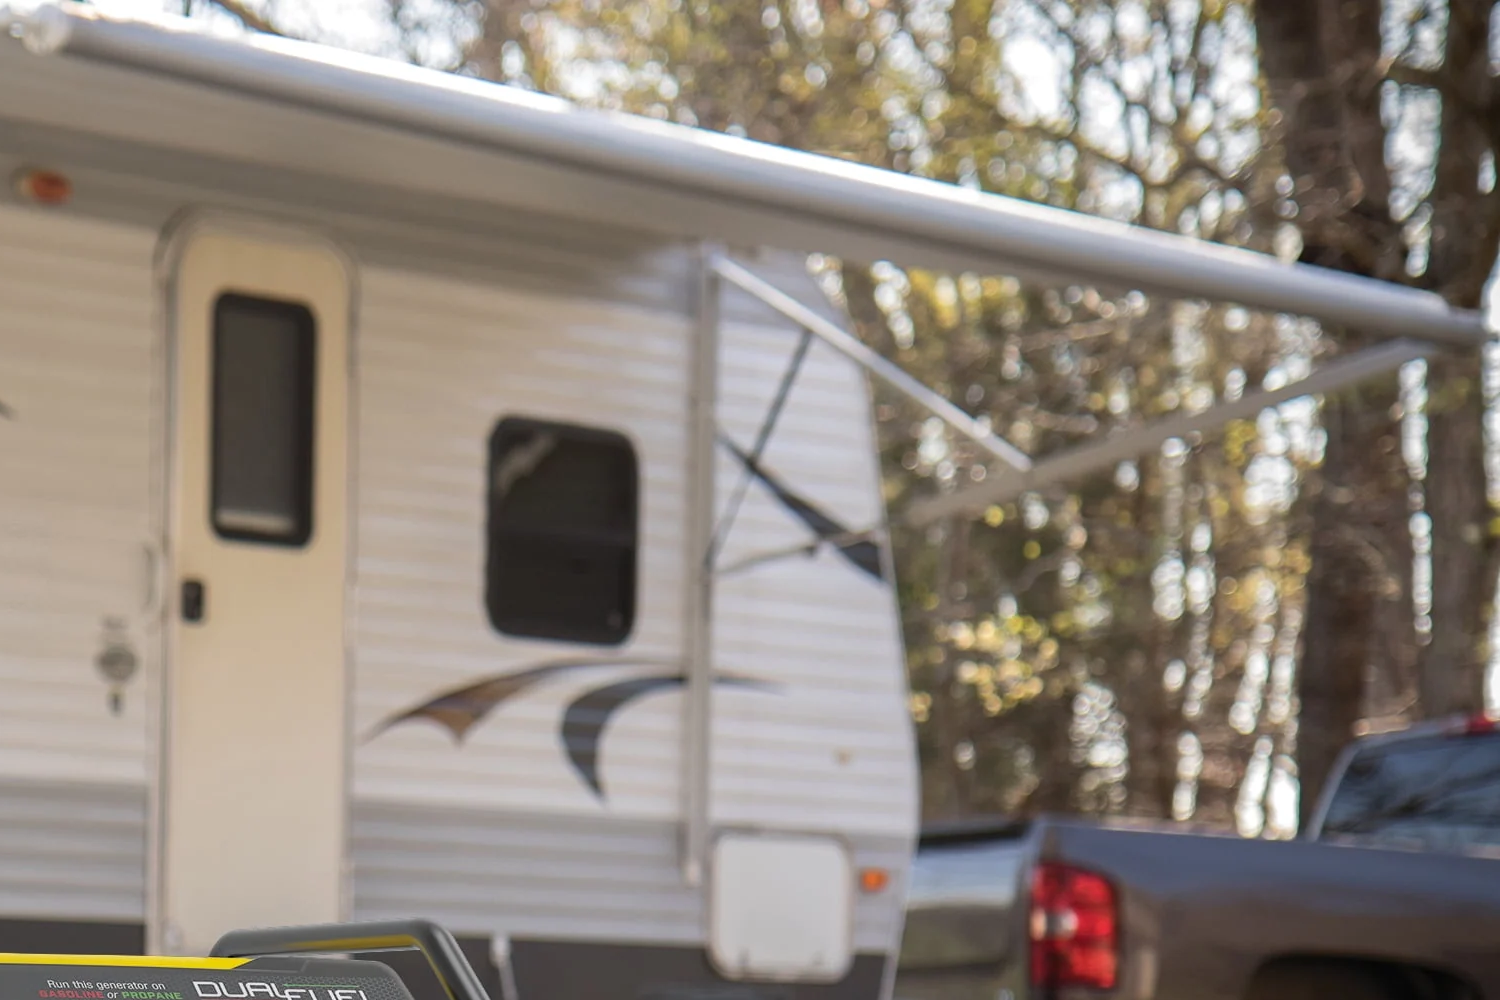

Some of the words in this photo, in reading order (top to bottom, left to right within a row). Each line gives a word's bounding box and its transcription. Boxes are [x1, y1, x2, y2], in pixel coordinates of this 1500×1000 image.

[47, 980, 70, 989] Run
[72, 980, 93, 990] this
[97, 981, 148, 992] generator
[38, 990, 104, 999] GASOLINE
[107, 991, 118, 999] or
[122, 991, 183, 1000] PROPANE
